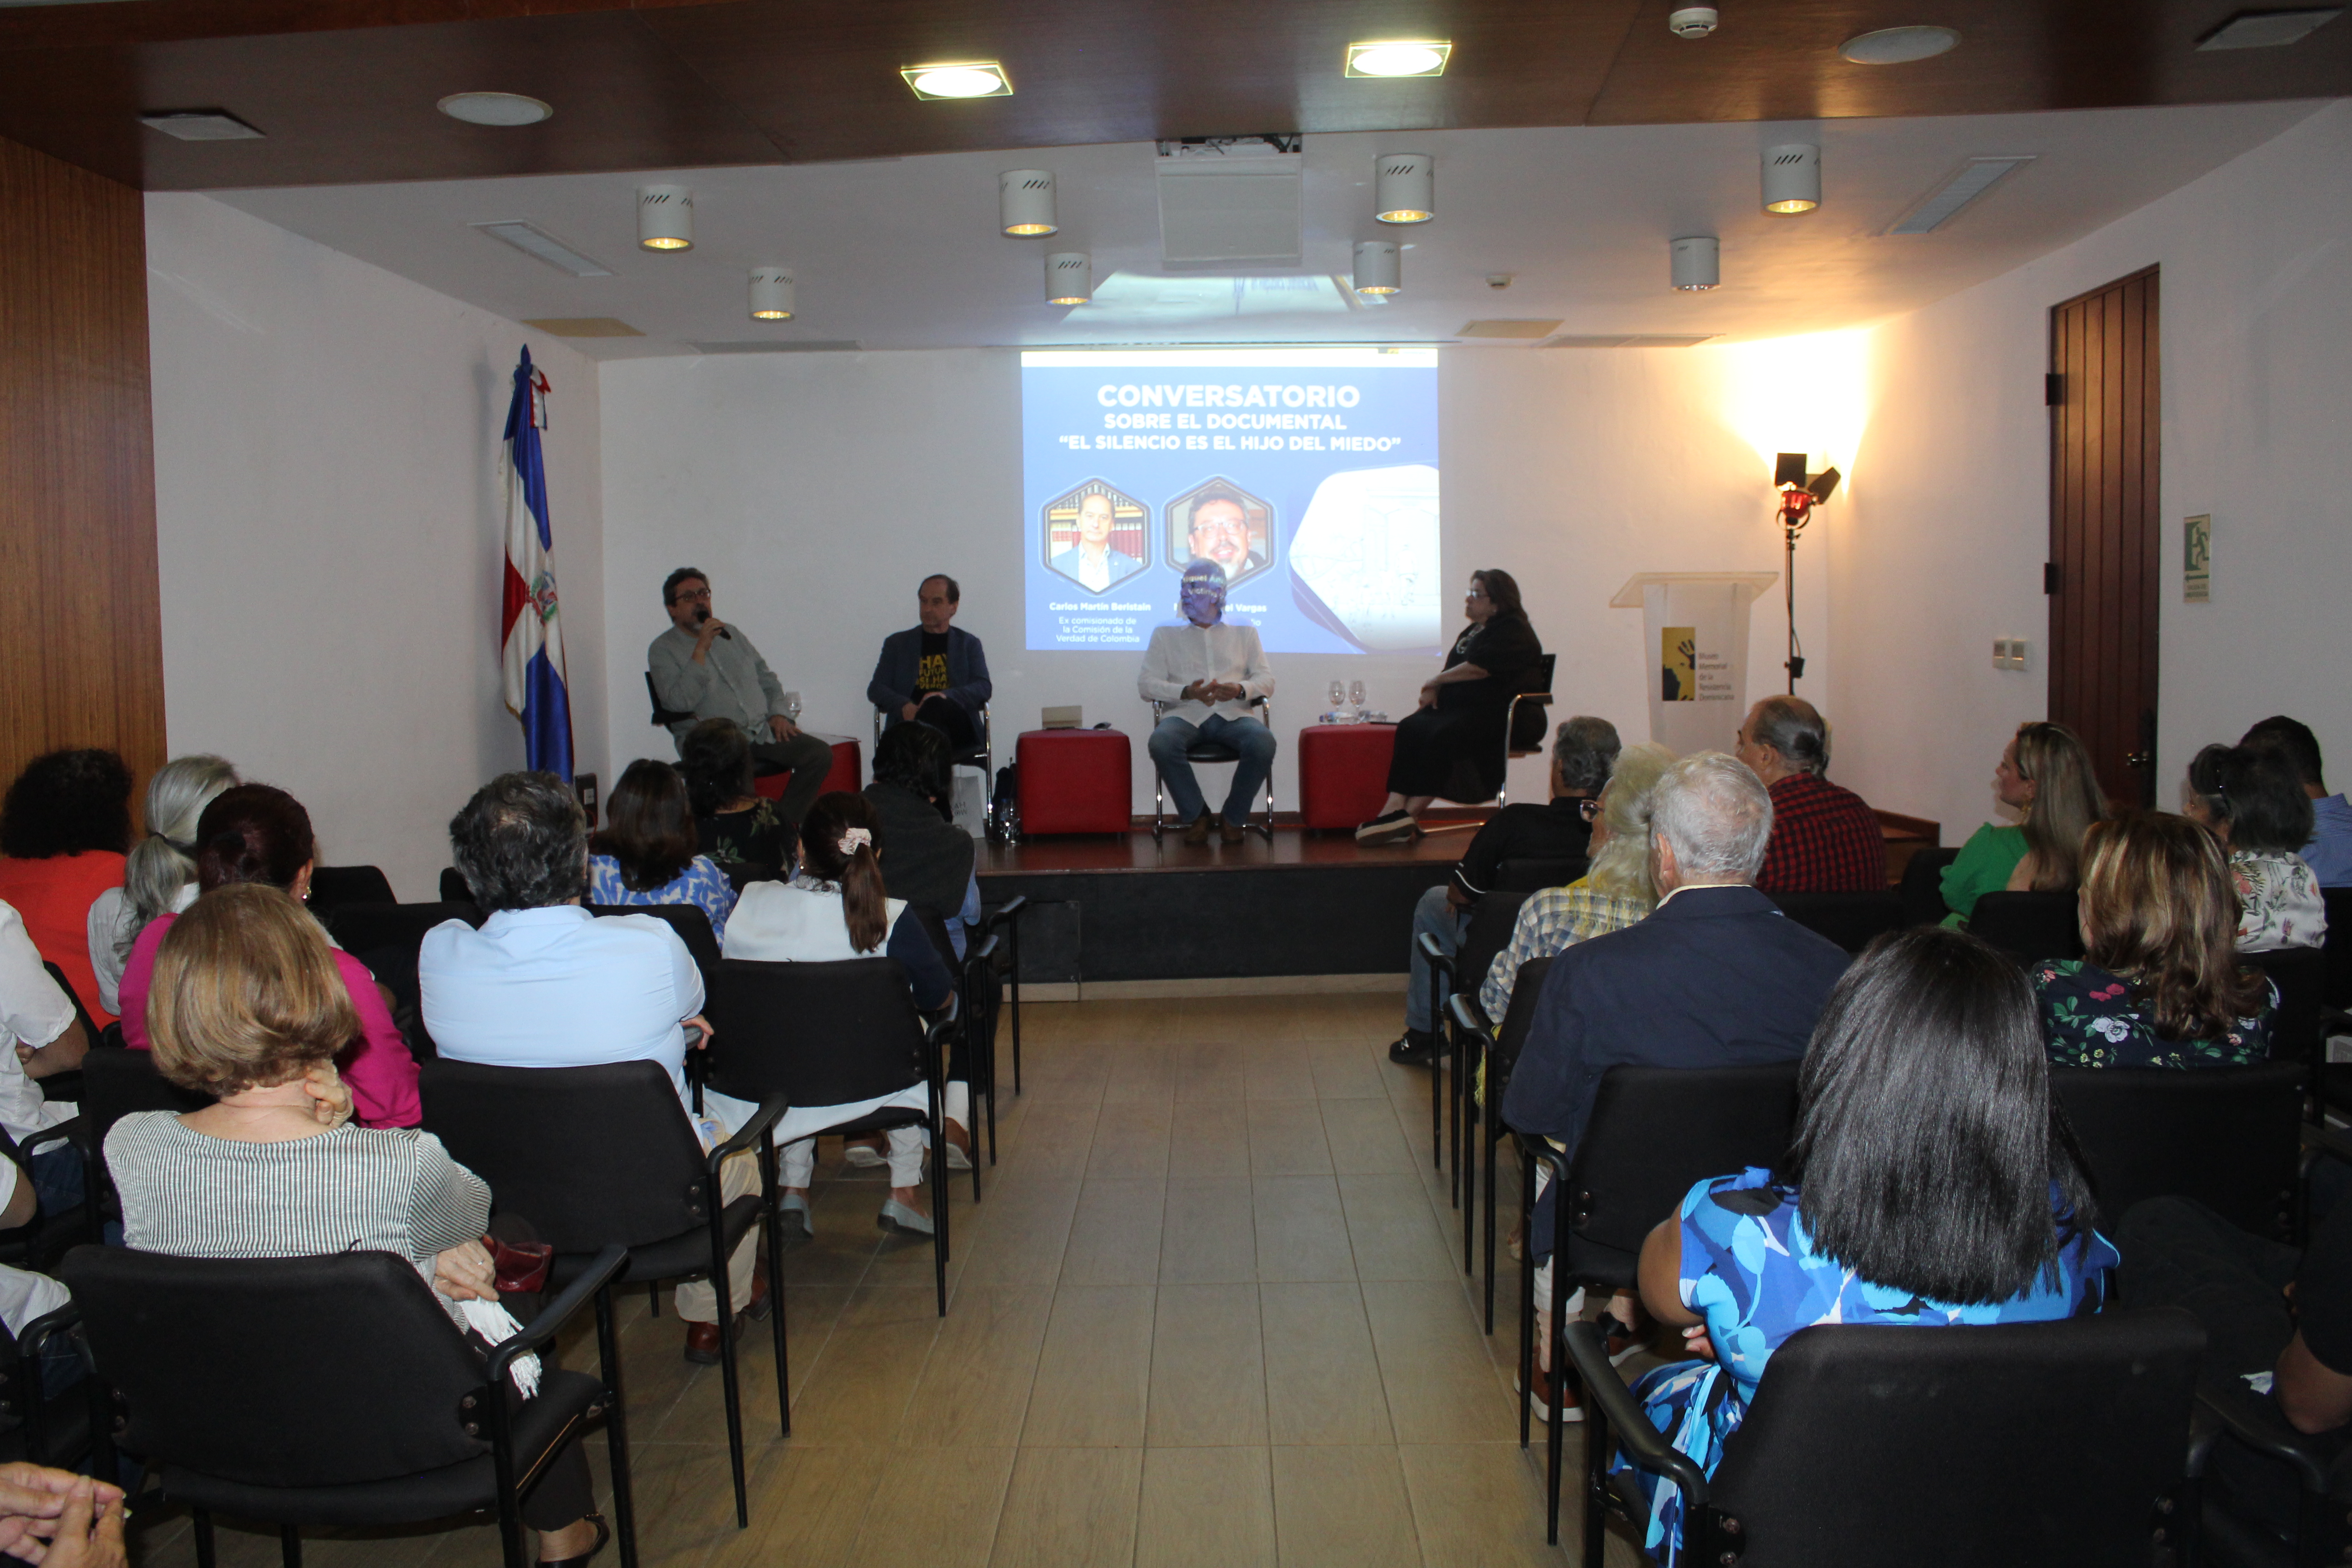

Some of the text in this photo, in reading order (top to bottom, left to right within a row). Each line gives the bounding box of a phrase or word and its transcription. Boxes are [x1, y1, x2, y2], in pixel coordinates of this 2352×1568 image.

[1097, 384, 1360, 408] CONVERSATORIO
[1104, 413, 1348, 430] SOBRE EL DOCUMENTAL
[1058, 435, 1401, 452] “EL SILENCIO ES EL HIJO DEL MIEDO”
[1049, 602, 1152, 611] Carlos Martín Beristain
[1235, 604, 1267, 613] Vargas
[1058, 616, 1069, 625] Ex
[1071, 617, 1124, 625] comisionado
[1072, 625, 1111, 634] Comisión
[1112, 626, 1123, 634] de
[1125, 626, 1133, 634] la
[1056, 634, 1086, 642] Verdad
[1100, 634, 1140, 643] Colombia
[919, 666, 946, 676] FUTUR
[933, 674, 947, 683] HA
